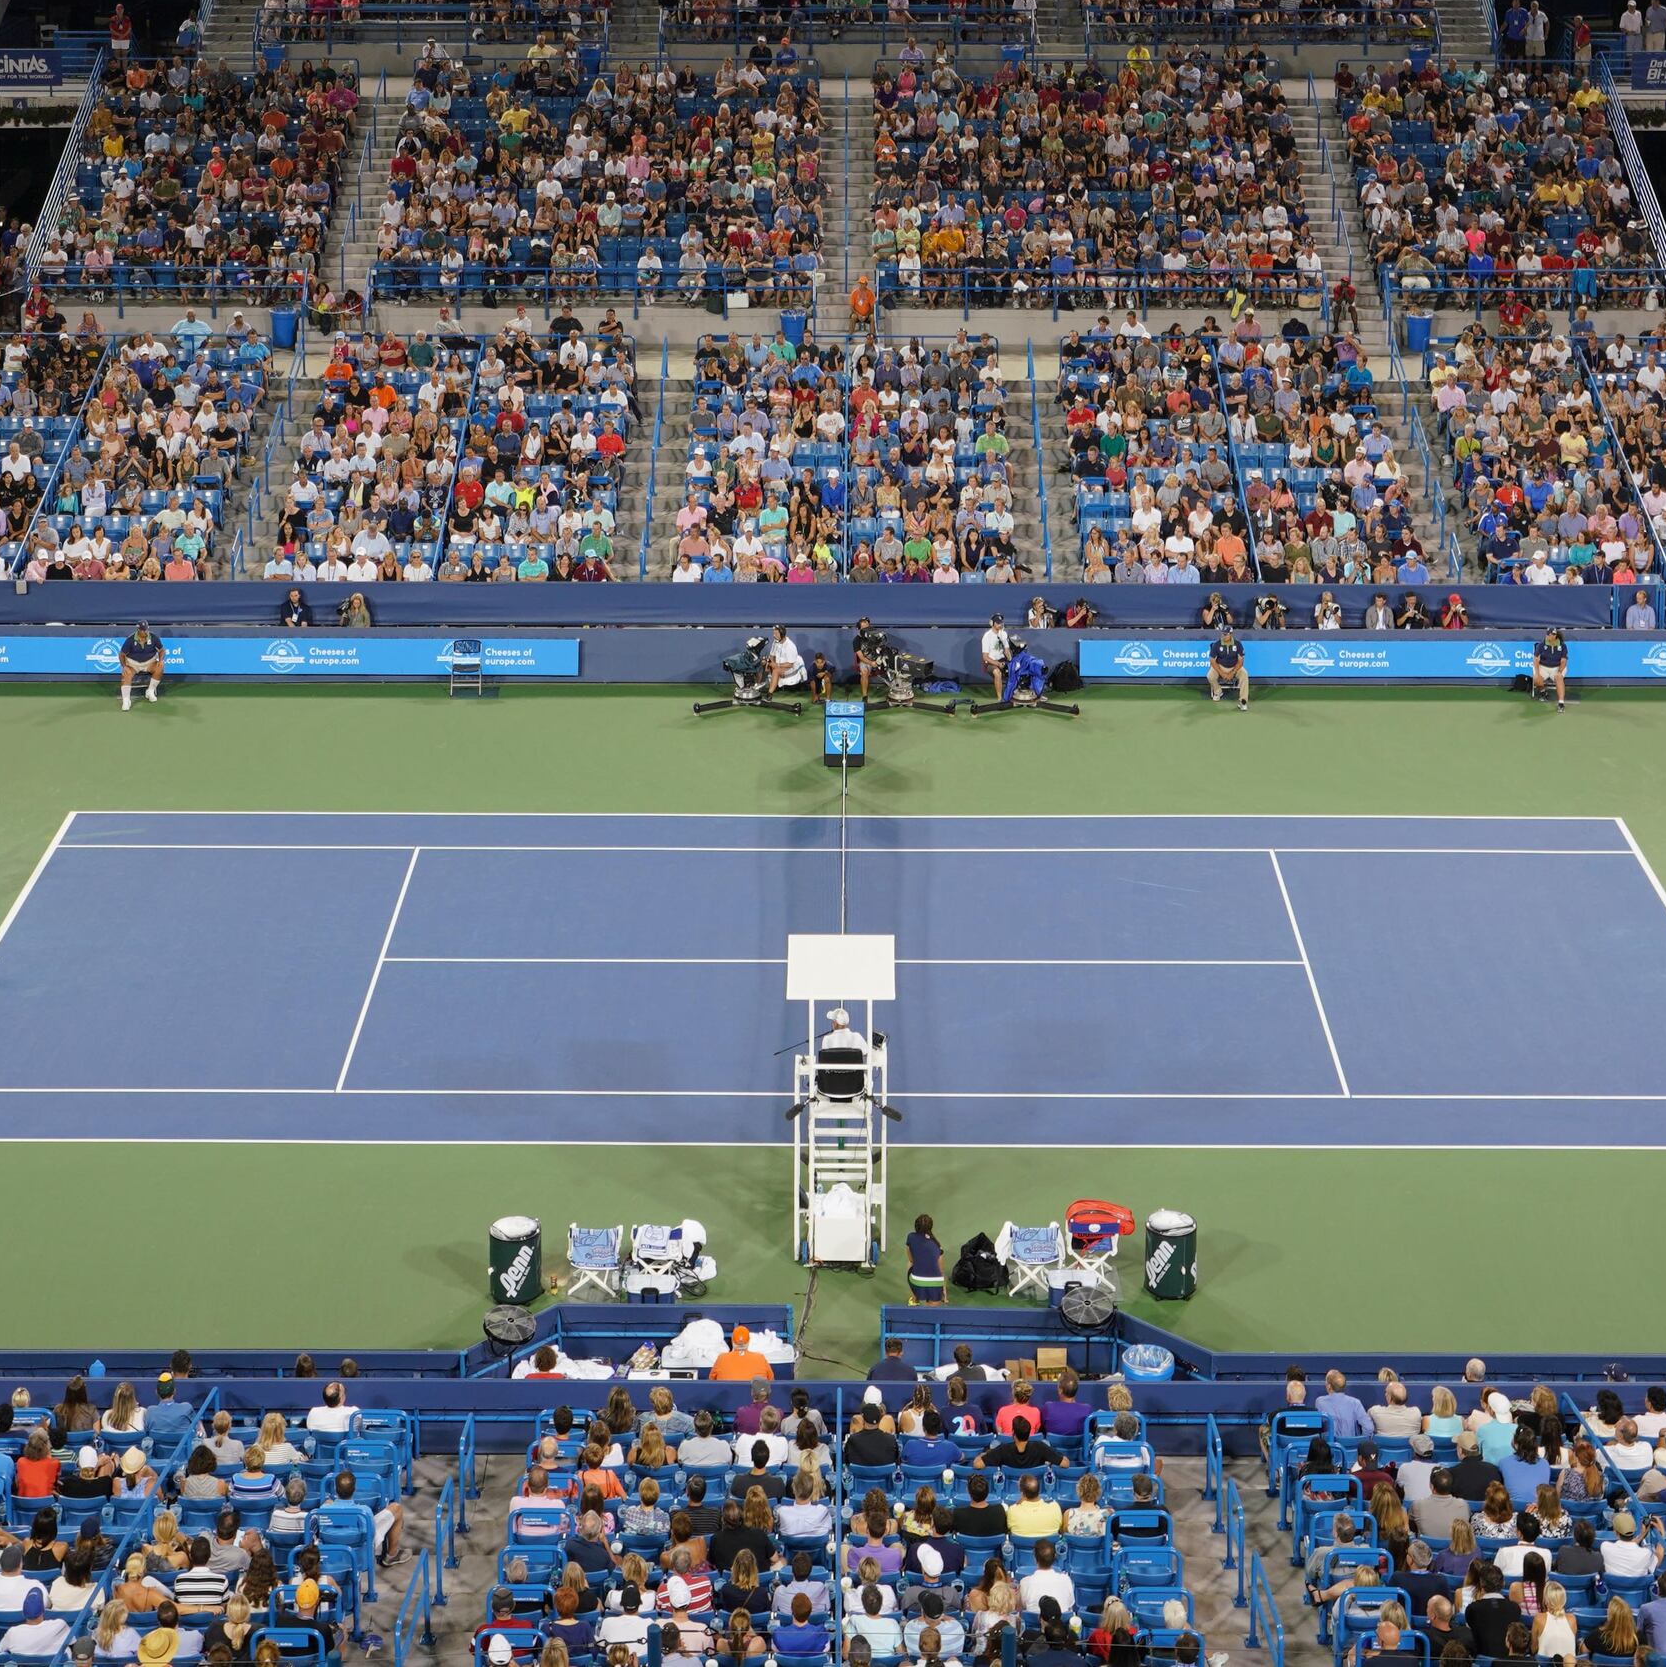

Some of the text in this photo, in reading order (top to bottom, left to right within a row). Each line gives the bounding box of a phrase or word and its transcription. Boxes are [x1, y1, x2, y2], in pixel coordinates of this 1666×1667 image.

[309, 647, 357, 656] Cheeses of
[485, 648, 533, 656] Cheeses of
[1163, 650, 1198, 658] Cheeses
[1339, 650, 1374, 658] Cheeses
[309, 658, 359, 666] europe.com
